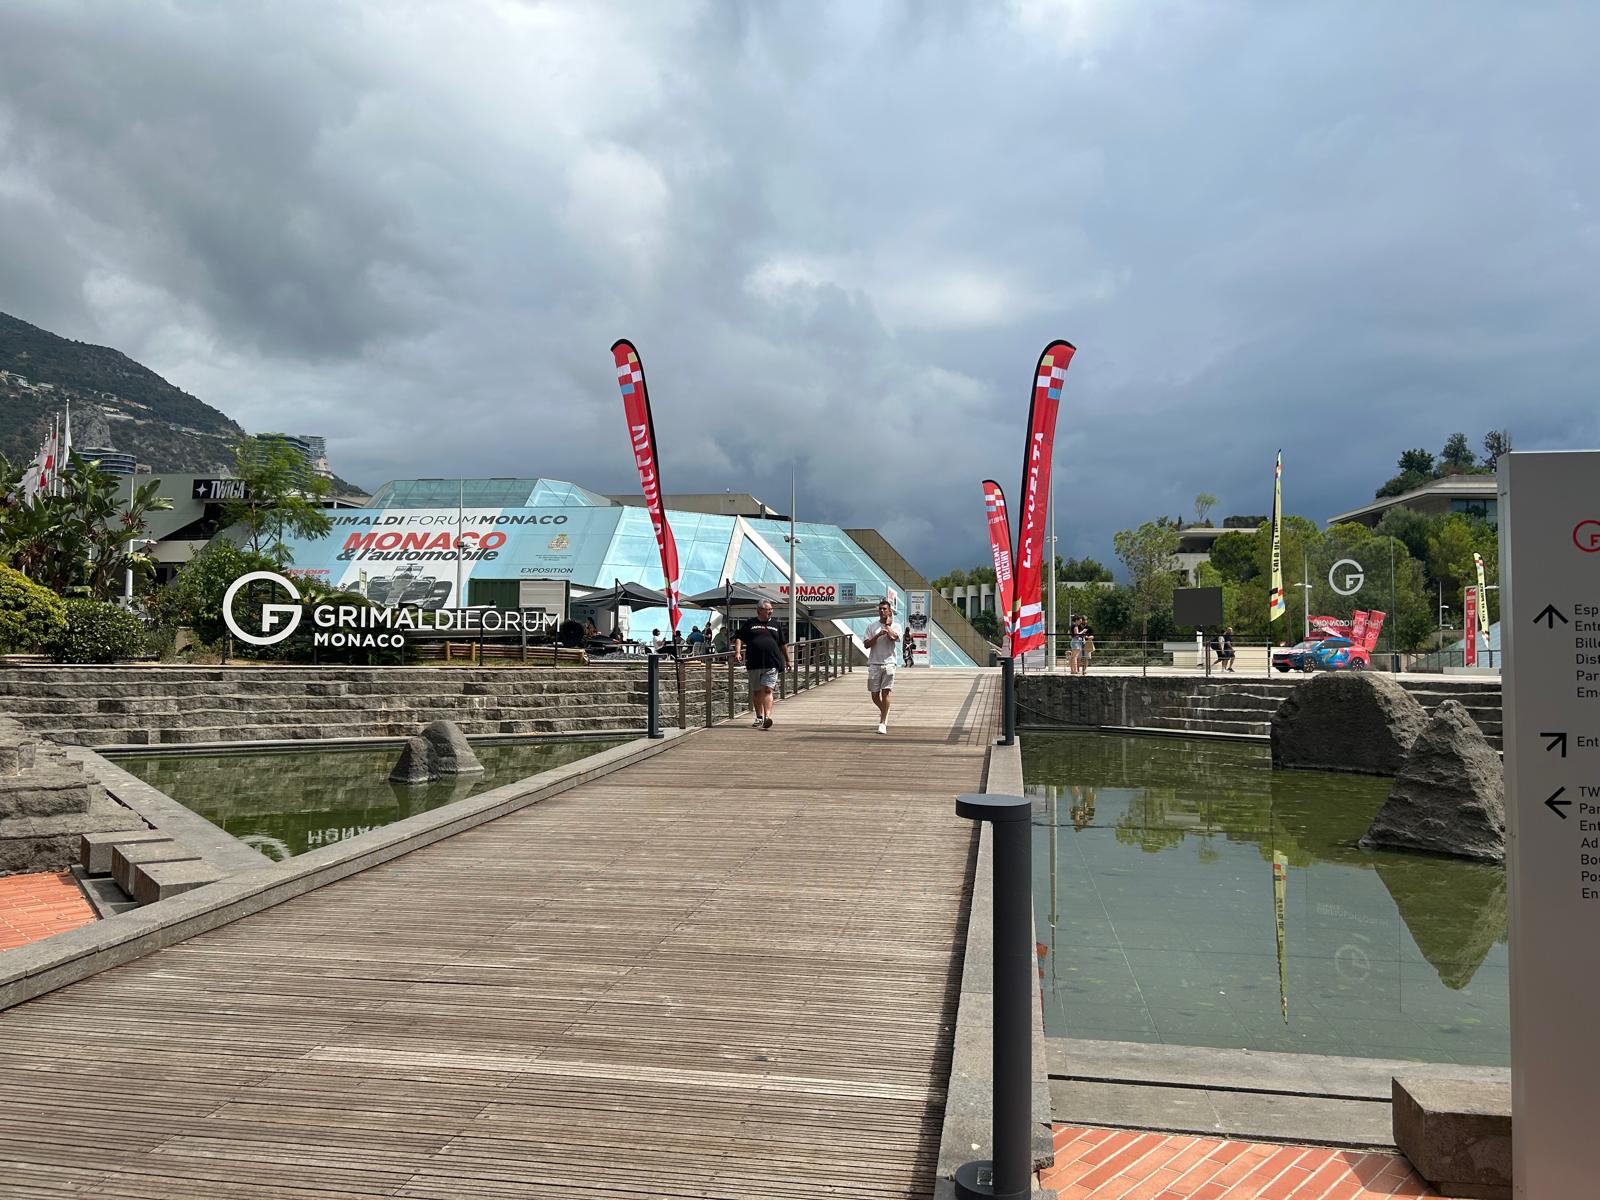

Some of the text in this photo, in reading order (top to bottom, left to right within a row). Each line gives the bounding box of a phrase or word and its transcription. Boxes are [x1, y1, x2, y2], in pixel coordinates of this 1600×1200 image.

[210, 480, 246, 499] TWIGA
[326, 515, 405, 526] RIMALDI
[478, 515, 568, 525] MONACO
[342, 531, 507, 551] MONACO
[779, 585, 836, 596] MNACO
[1574, 603, 1599, 618] Esp
[313, 632, 405, 648] MONACO
[1577, 687, 1600, 698] Em
[1577, 735, 1600, 748] Ent
[1578, 785, 1600, 798] TW
[1581, 837, 1599, 849] Ad
[1581, 853, 1600, 866] Bo
[1582, 887, 1600, 899] En
